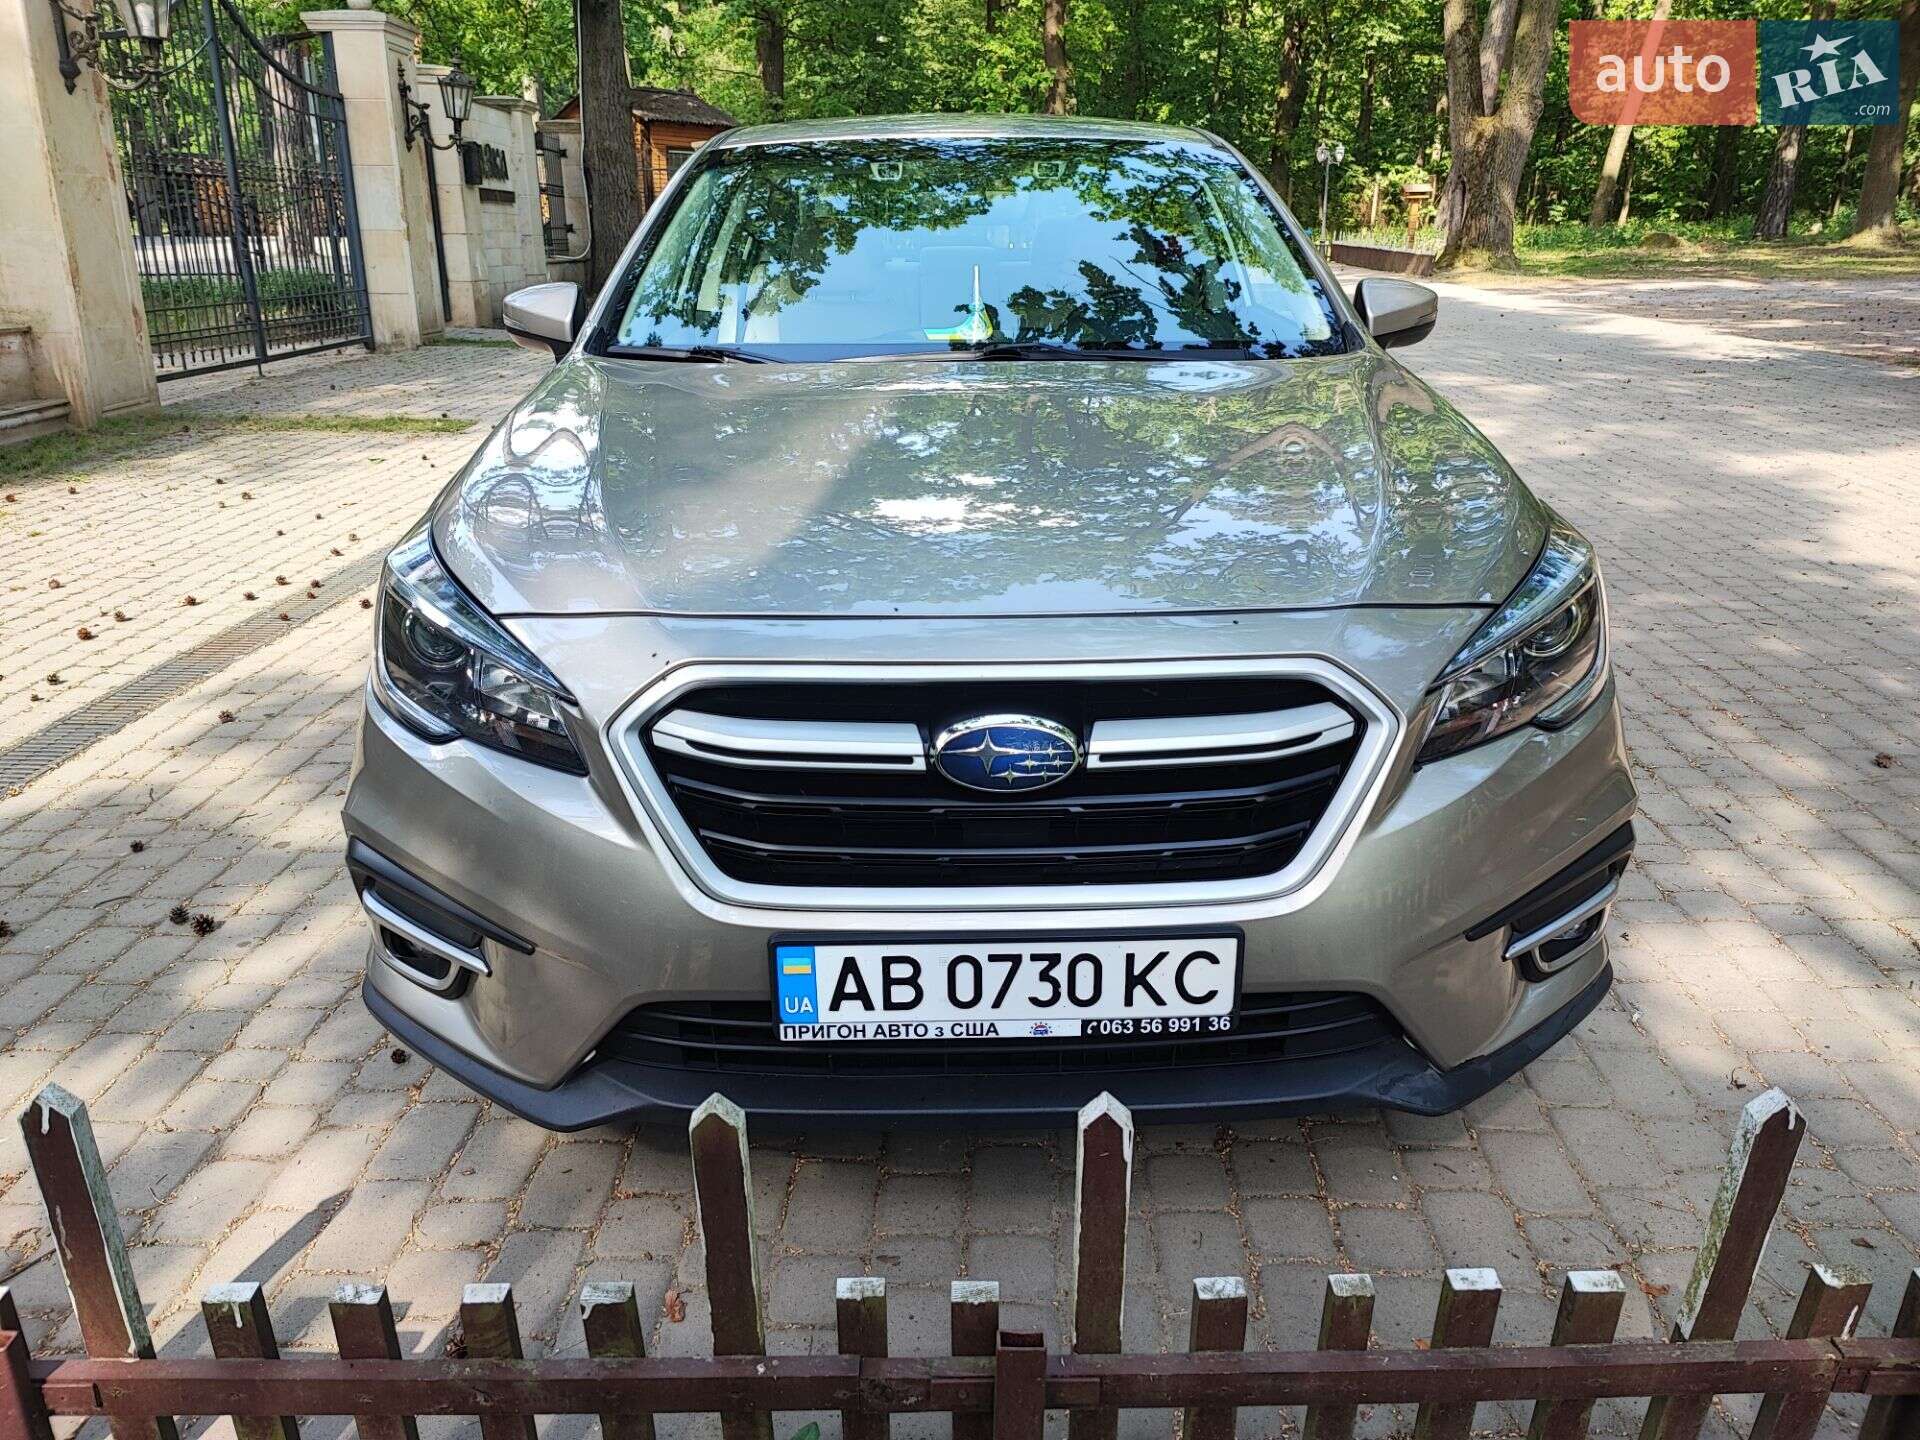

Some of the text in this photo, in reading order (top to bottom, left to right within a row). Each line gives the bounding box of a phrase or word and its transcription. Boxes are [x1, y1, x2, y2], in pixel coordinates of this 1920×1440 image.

[828, 950, 1221, 1012] AB 0730 KC
[784, 997, 814, 1014] UA
[783, 1024, 867, 1039] ПРИГОН
[873, 1023, 928, 1038] АВТО
[950, 1022, 1000, 1037] США
[1100, 1016, 1231, 1034] 063 56 991 36
